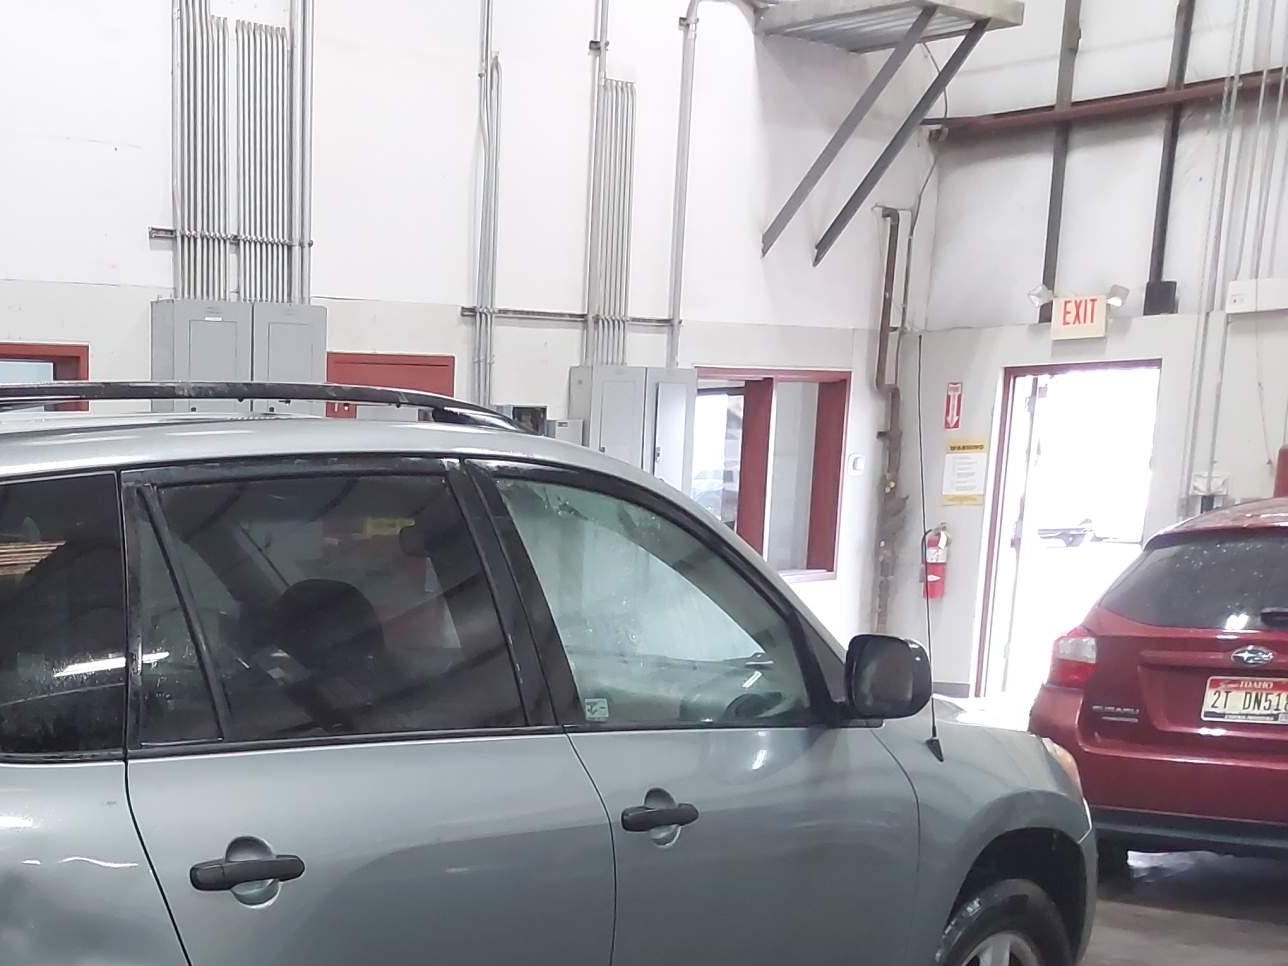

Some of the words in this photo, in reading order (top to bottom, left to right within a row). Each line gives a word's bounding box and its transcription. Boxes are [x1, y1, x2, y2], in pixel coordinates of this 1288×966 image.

[1063, 298, 1097, 325] EXIT
[1240, 681, 1273, 689] IDAHO
[1211, 690, 1231, 709] 2T
